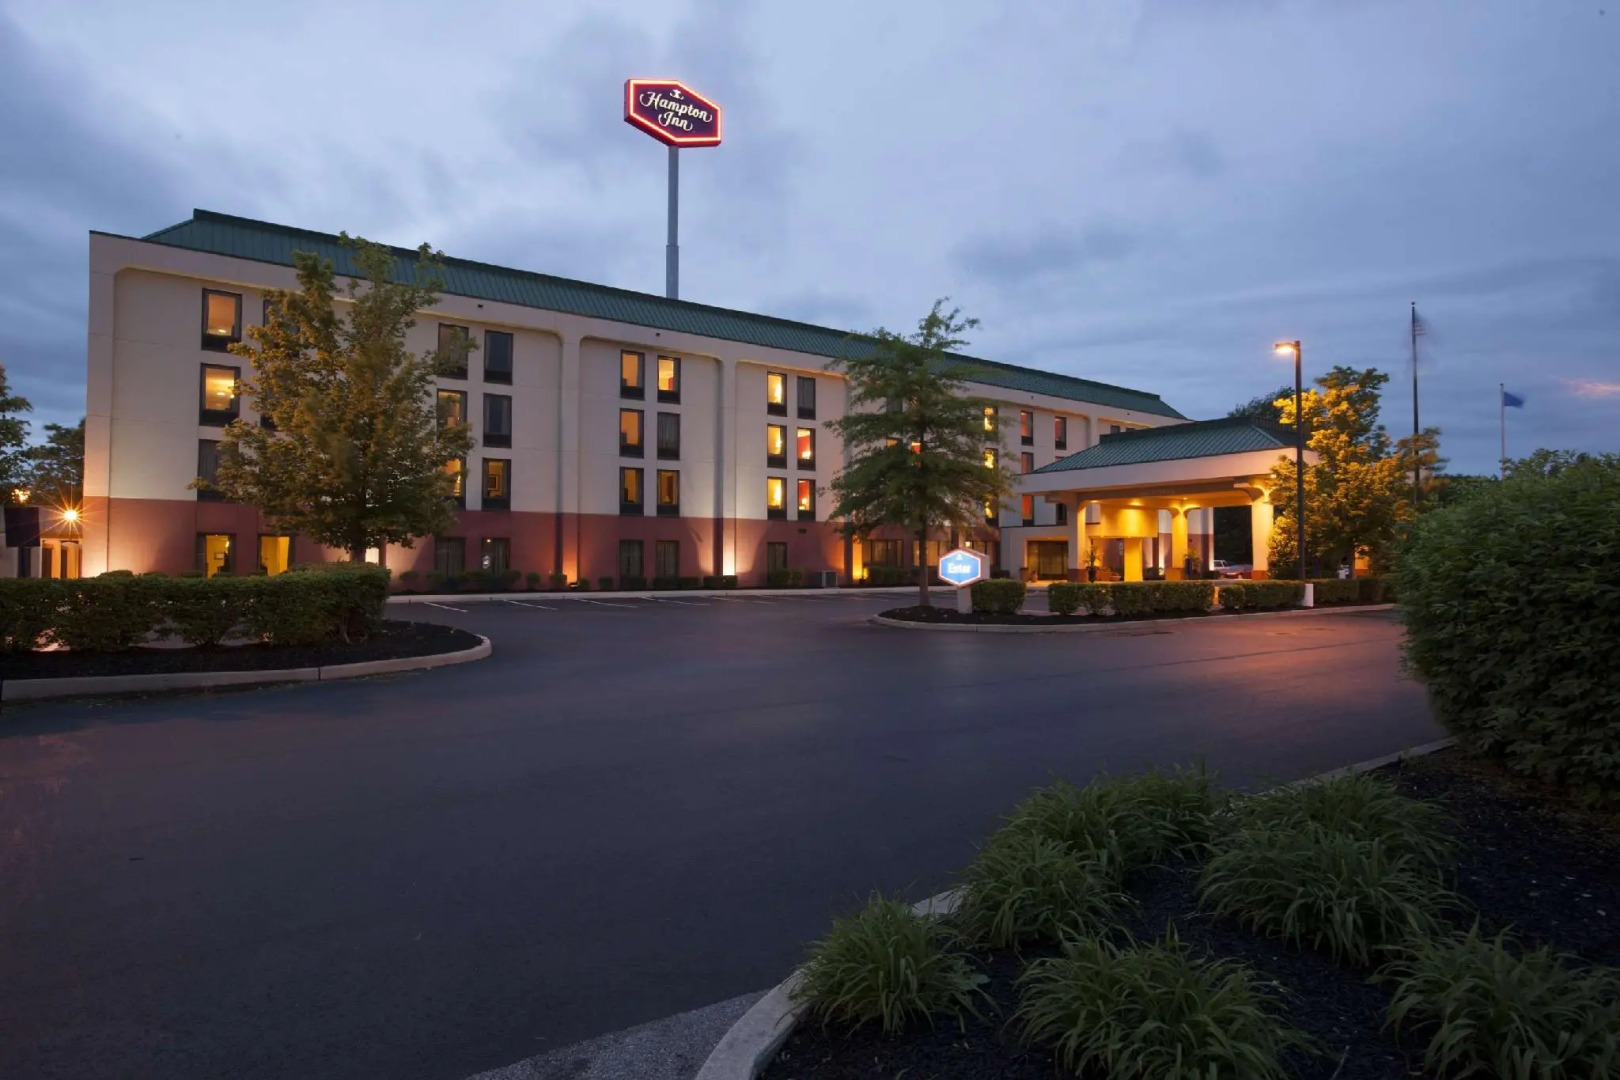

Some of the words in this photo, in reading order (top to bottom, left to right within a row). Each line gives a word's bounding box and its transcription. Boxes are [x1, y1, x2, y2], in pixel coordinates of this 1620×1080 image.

[639, 91, 712, 122] Hampton
[658, 112, 693, 131] Inn
[948, 563, 972, 574] Enter
